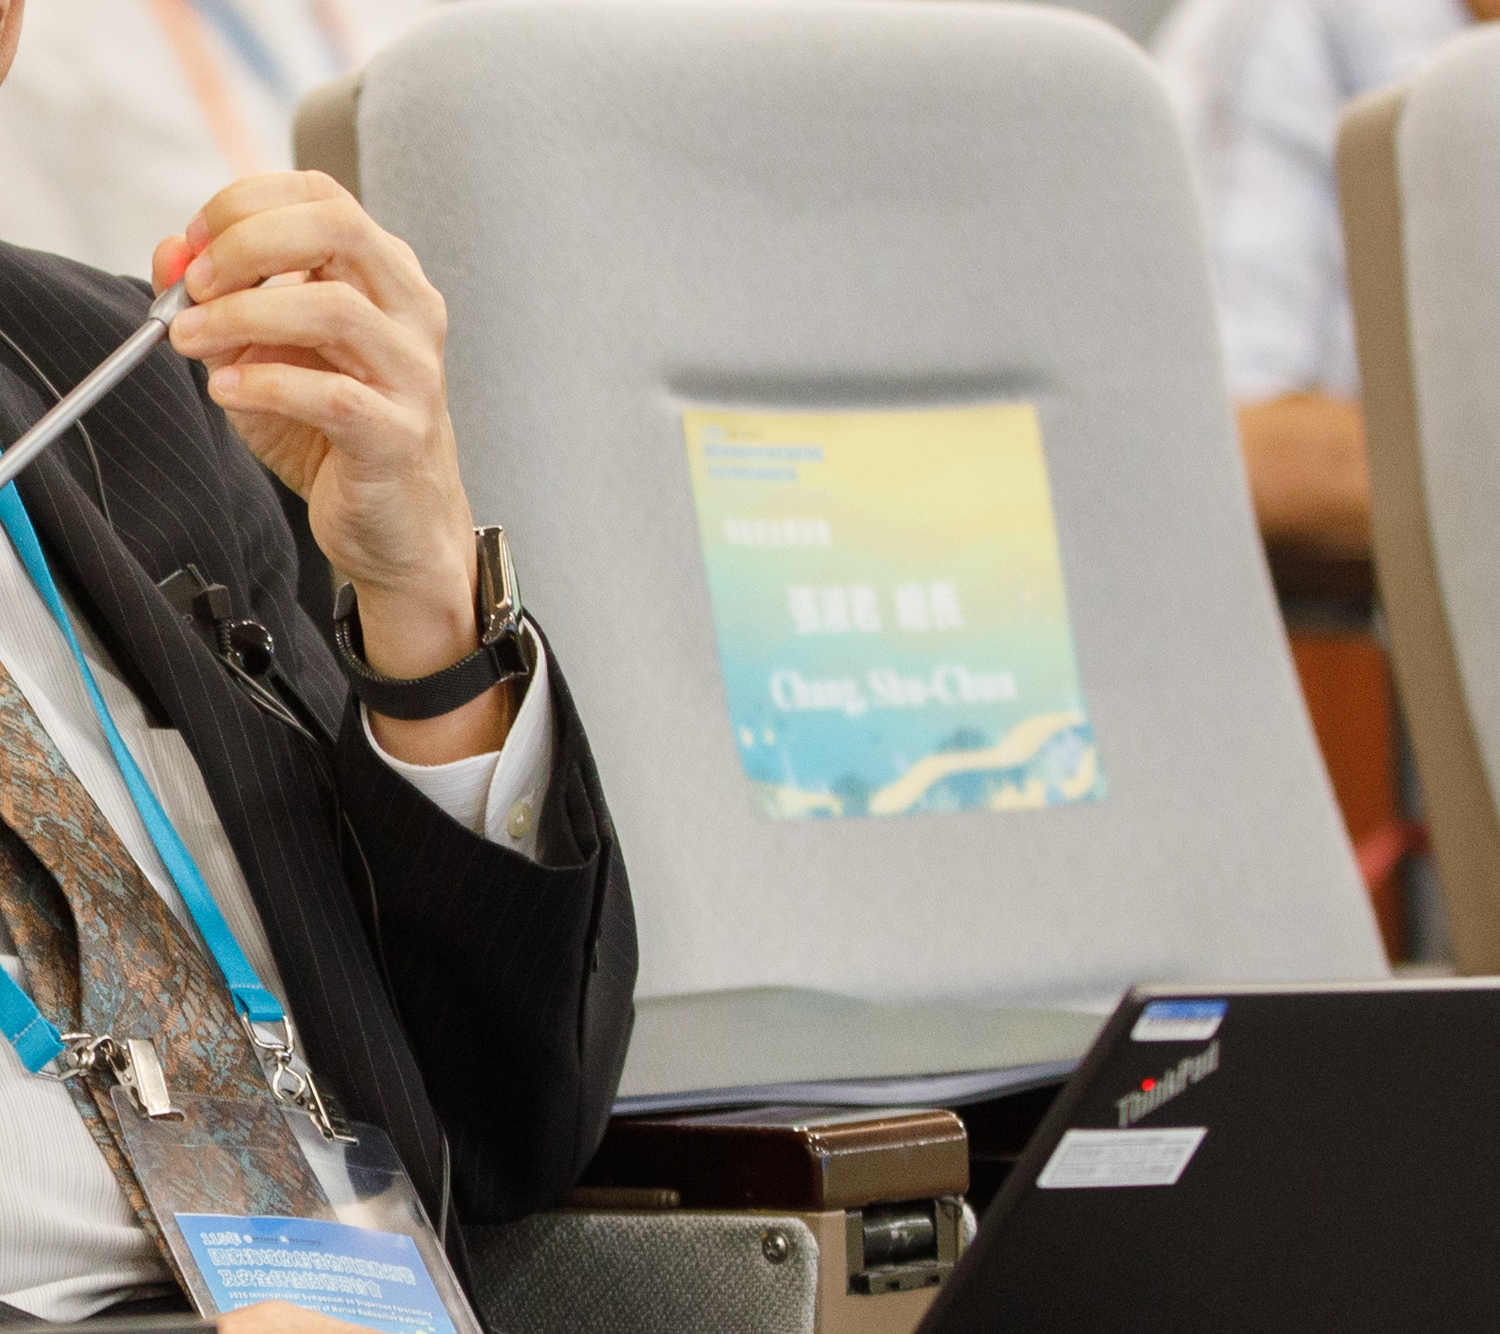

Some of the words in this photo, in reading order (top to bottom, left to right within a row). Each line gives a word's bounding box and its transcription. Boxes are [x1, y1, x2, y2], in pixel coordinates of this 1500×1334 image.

[1115, 1038, 1219, 1129] ThinkPad
[249, 1292, 301, 1301] International
[301, 1294, 345, 1304] Symposium
[355, 1298, 393, 1311] Dispersion
[330, 1305, 357, 1316] Marine
[356, 1308, 399, 1321] Radioactive
